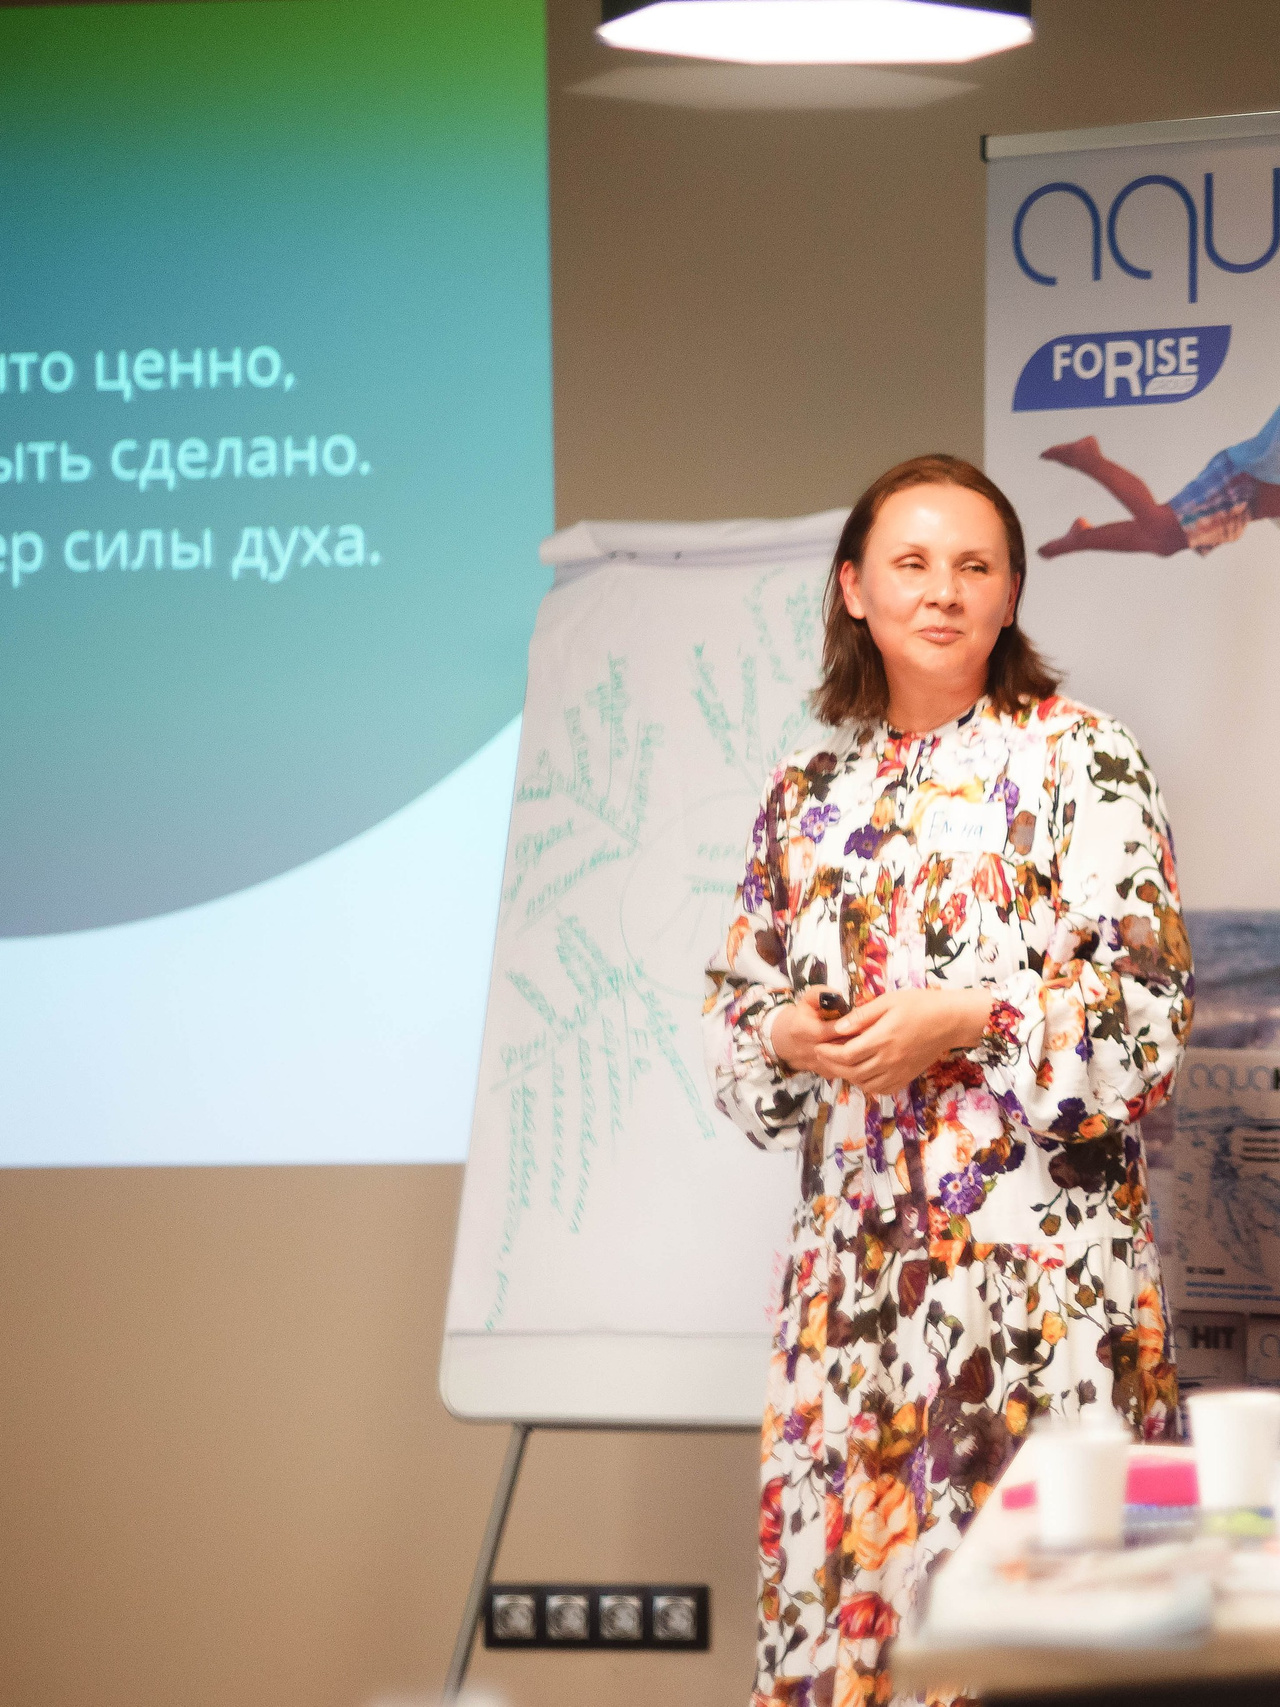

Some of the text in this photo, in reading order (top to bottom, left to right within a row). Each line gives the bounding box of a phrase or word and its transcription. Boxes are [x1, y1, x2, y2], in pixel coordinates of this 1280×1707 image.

[0, 344, 297, 402] то ценно,
[1052, 336, 1199, 399] FORISE
[110, 432, 372, 492] сделано.
[63, 525, 213, 573] силы
[231, 522, 383, 584] духа.
[1175, 1325, 1236, 1350] aHIT
